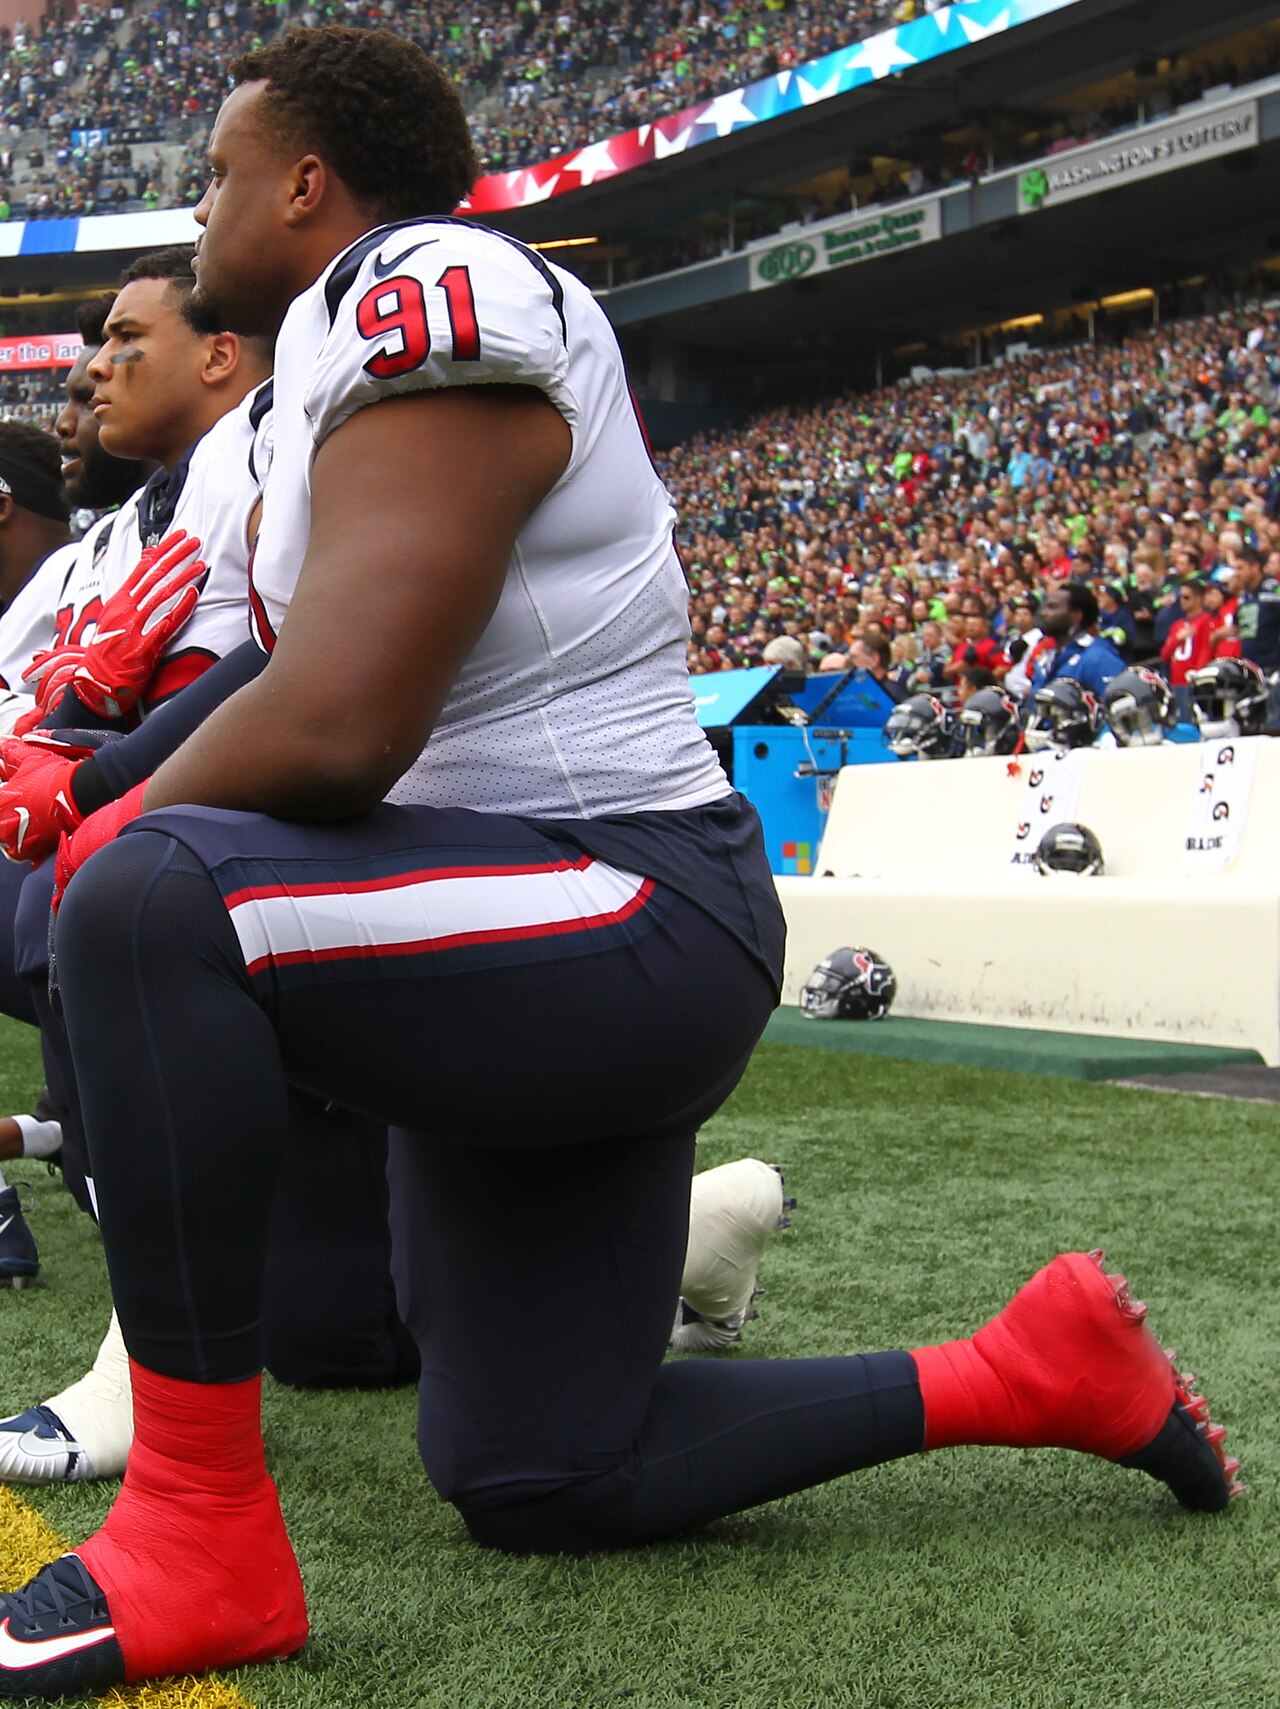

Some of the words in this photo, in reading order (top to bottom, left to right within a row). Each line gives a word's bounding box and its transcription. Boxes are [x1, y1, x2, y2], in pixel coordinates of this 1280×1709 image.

[1176, 113, 1253, 152] LOTTERY
[356, 265, 480, 379] 91
[18, 342, 51, 362] the
